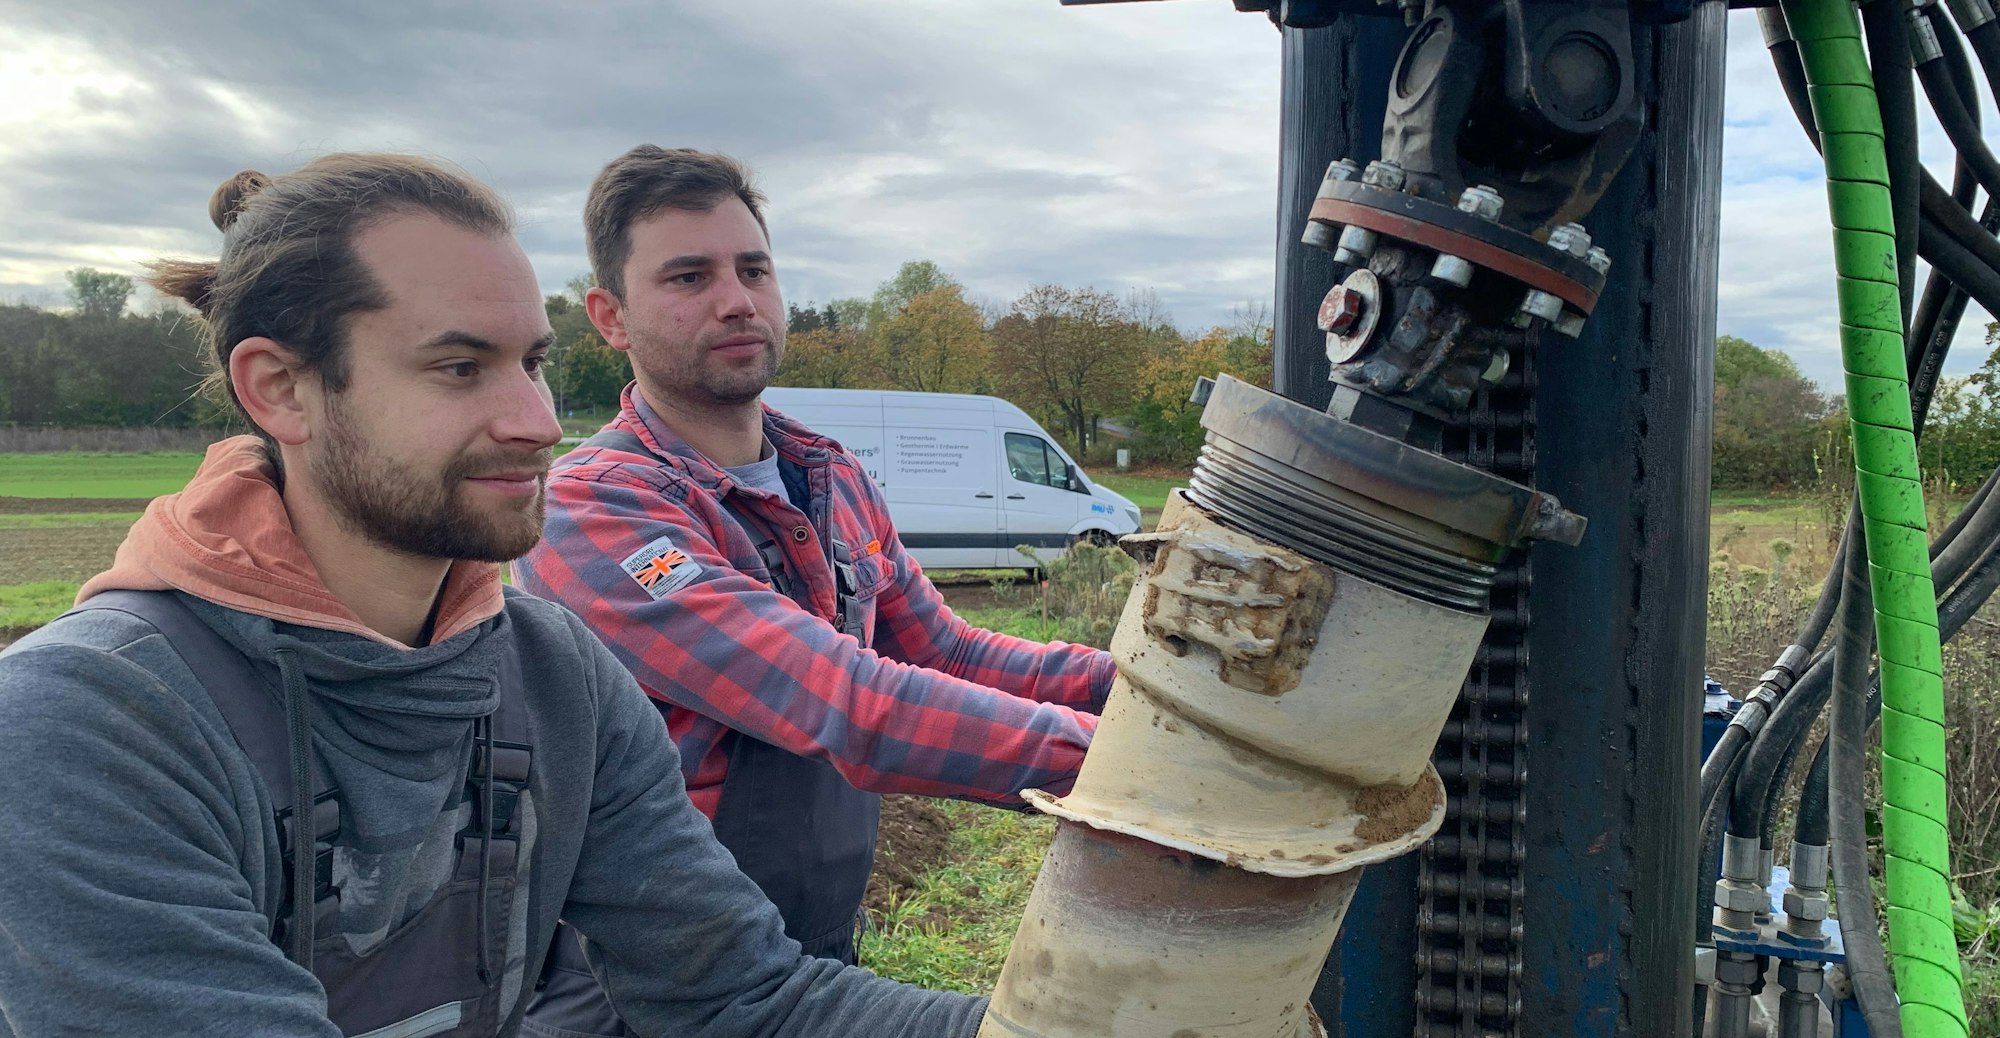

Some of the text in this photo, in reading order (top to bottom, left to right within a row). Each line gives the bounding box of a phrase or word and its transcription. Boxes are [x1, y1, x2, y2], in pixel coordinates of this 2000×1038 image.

[900, 451, 962, 459] Regenwassernutzung
[900, 459, 959, 467] Grauwassernutzung
[626, 546, 654, 568] SUPERDRY
